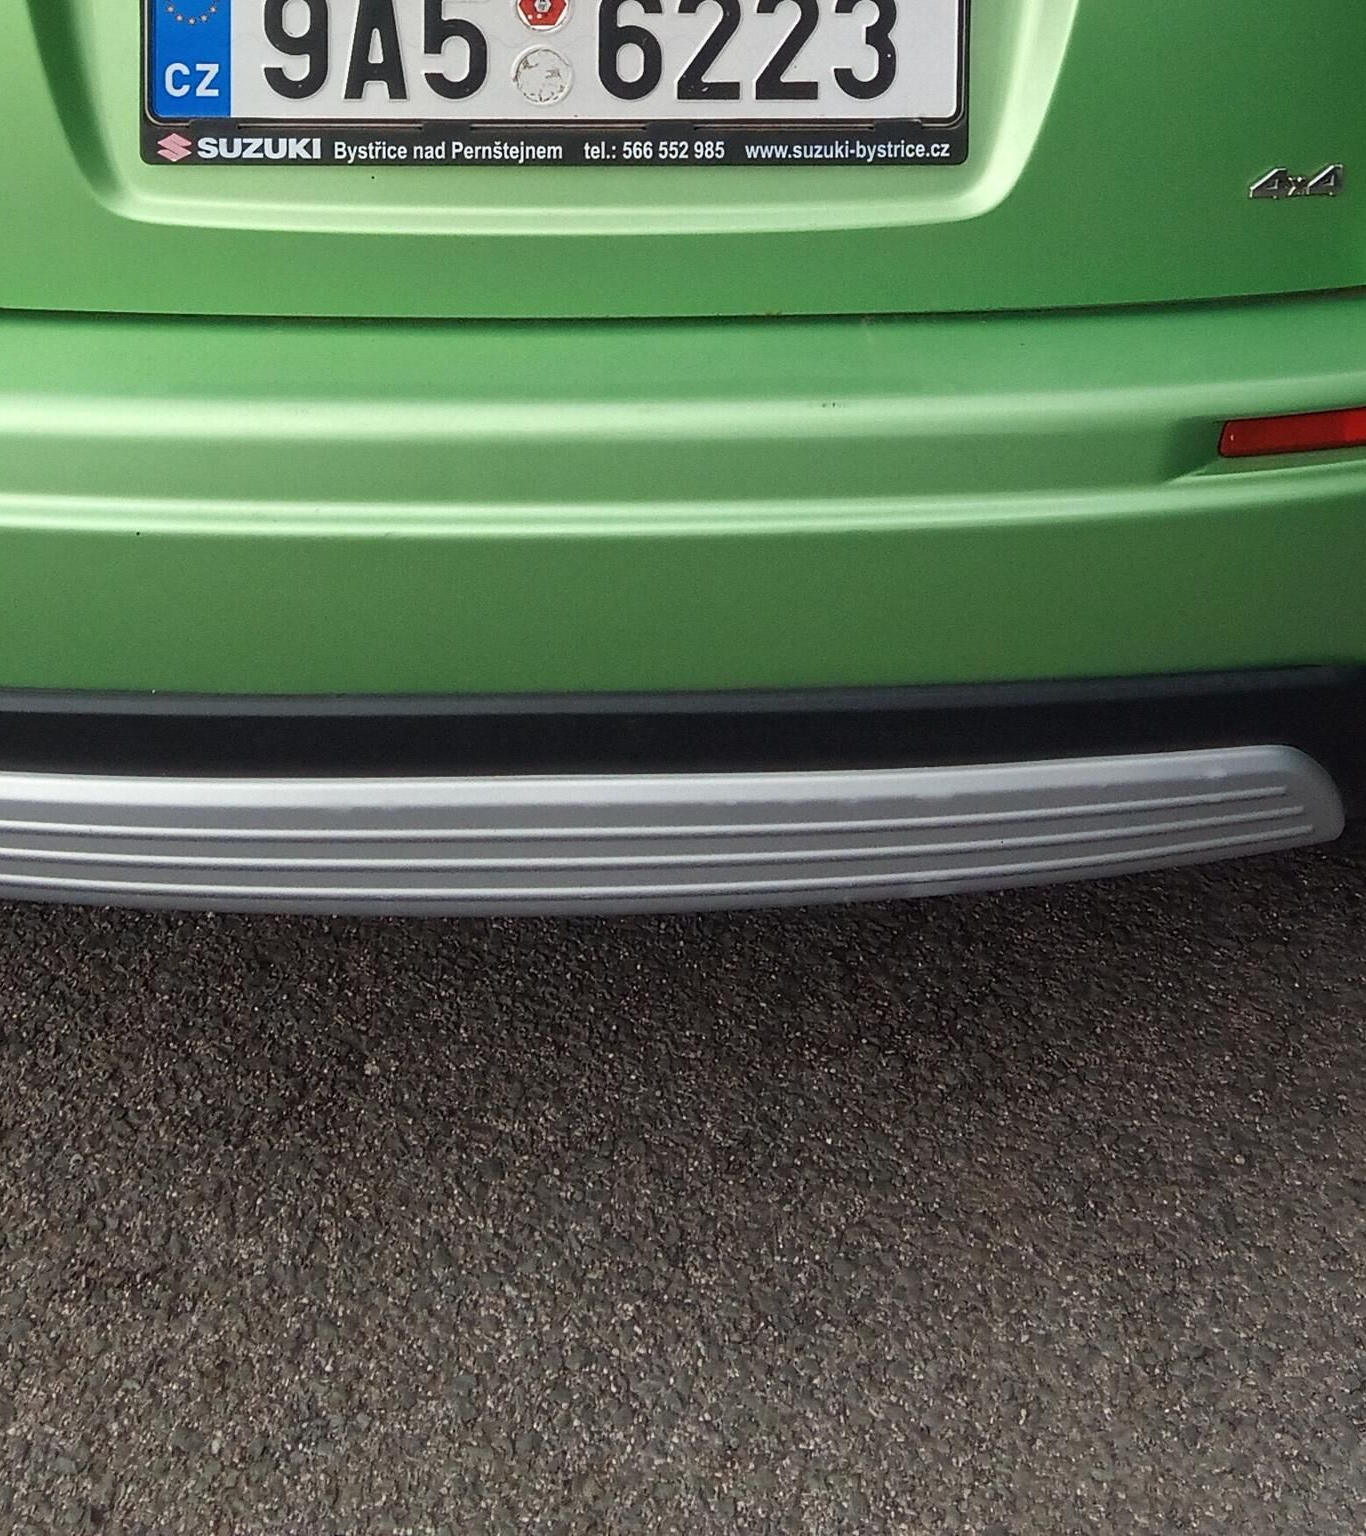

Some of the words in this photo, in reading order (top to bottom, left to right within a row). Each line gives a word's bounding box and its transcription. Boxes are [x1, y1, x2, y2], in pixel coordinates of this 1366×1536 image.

[164, 62, 221, 97] CZ
[197, 137, 322, 160] SUZUKI
[334, 140, 409, 165] Bystřice
[413, 141, 446, 160] nad
[451, 140, 563, 165] Pernštejnem
[583, 140, 617, 160] tel.:
[622, 141, 656, 160] 566
[658, 141, 690, 160] 552
[693, 141, 726, 160] 985
[744, 139, 951, 163] www.suzuki-bystrice.cz
